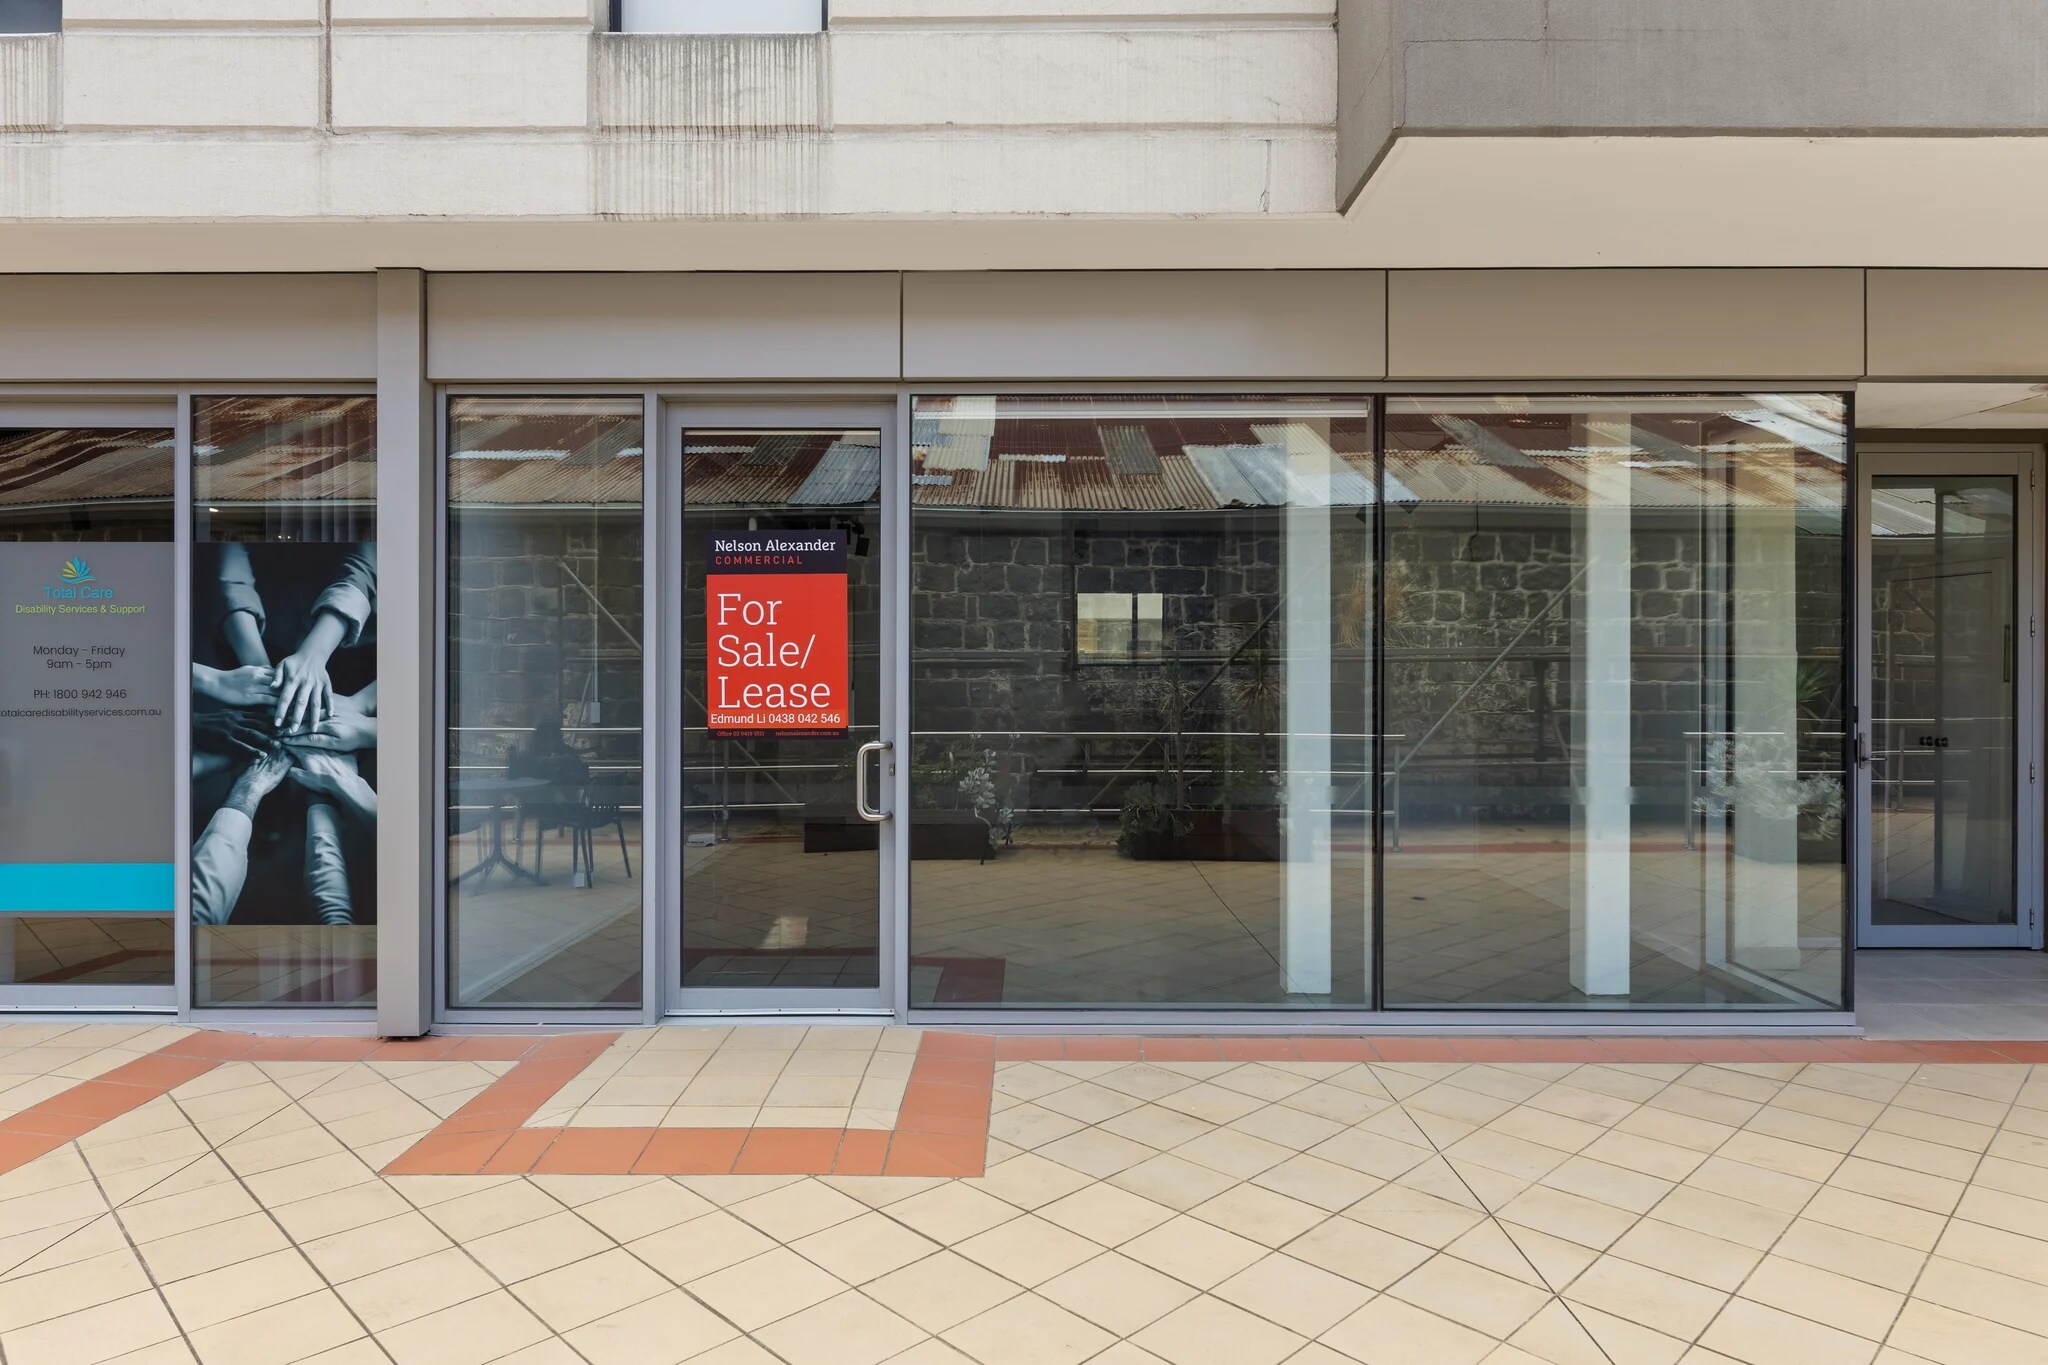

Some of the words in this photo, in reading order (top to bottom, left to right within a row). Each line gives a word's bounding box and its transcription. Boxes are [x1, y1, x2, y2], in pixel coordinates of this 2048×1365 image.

[714, 539, 762, 552] Nelson
[765, 539, 836, 552] Alexander
[715, 555, 803, 565] COMMERCIAL
[44, 586, 77, 599] Total
[81, 586, 113, 599] Care
[15, 604, 56, 616] Disability
[58, 604, 98, 614] Services
[100, 604, 107, 614] &
[110, 604, 146, 617] Support
[717, 593, 782, 626] For
[33, 645, 79, 657] Monday
[91, 645, 126, 657] Friday
[717, 632, 816, 669] Sale/
[46, 659, 73, 669] 9am
[85, 659, 112, 671] 5pm
[33, 689, 51, 699] PH:
[53, 689, 78, 699] 1800
[81, 689, 102, 699] 942
[105, 689, 127, 699] 946
[717, 676, 831, 709] Lease
[711, 713, 754, 724] Edmund
[757, 713, 766, 724] Li
[769, 713, 795, 724] 0438
[798, 713, 818, 724] 042
[821, 713, 841, 724] 546
